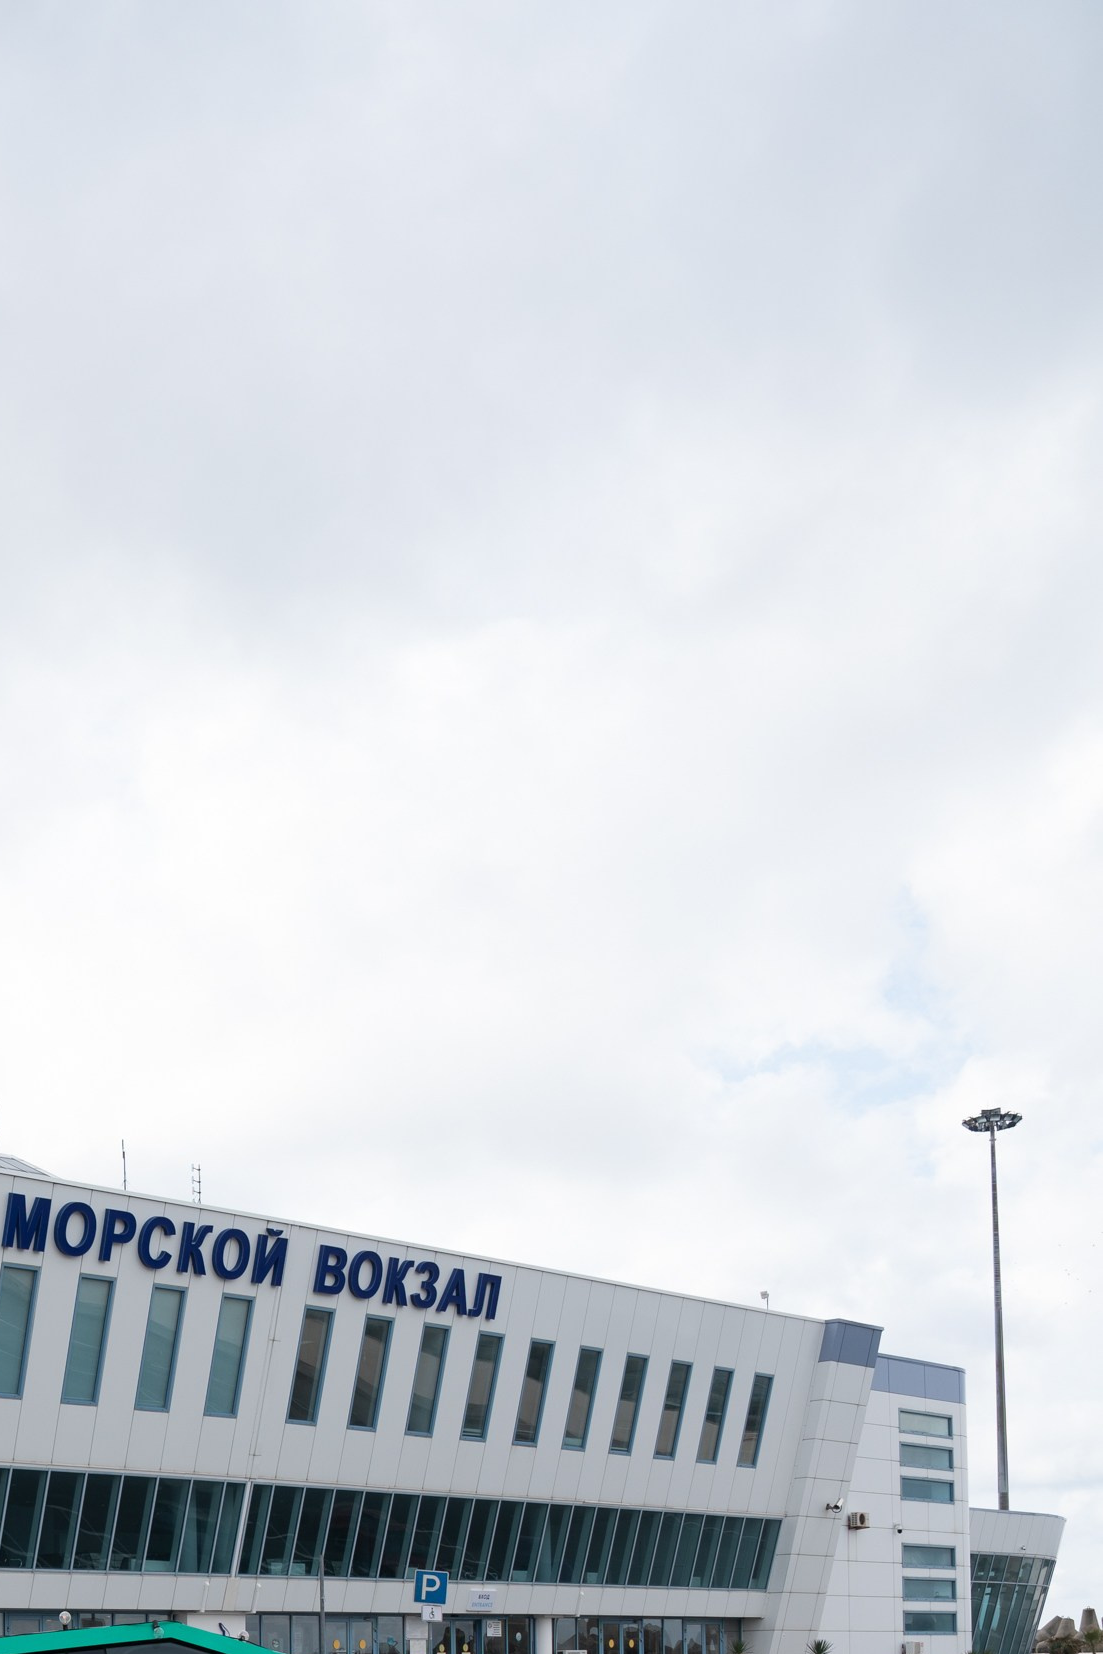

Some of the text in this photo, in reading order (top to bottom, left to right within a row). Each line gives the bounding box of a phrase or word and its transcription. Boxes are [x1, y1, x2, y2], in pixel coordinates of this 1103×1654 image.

[1, 1192, 502, 1321] МОРСКОЙ ВОКЗАЛ
[421, 1574, 441, 1601] P
